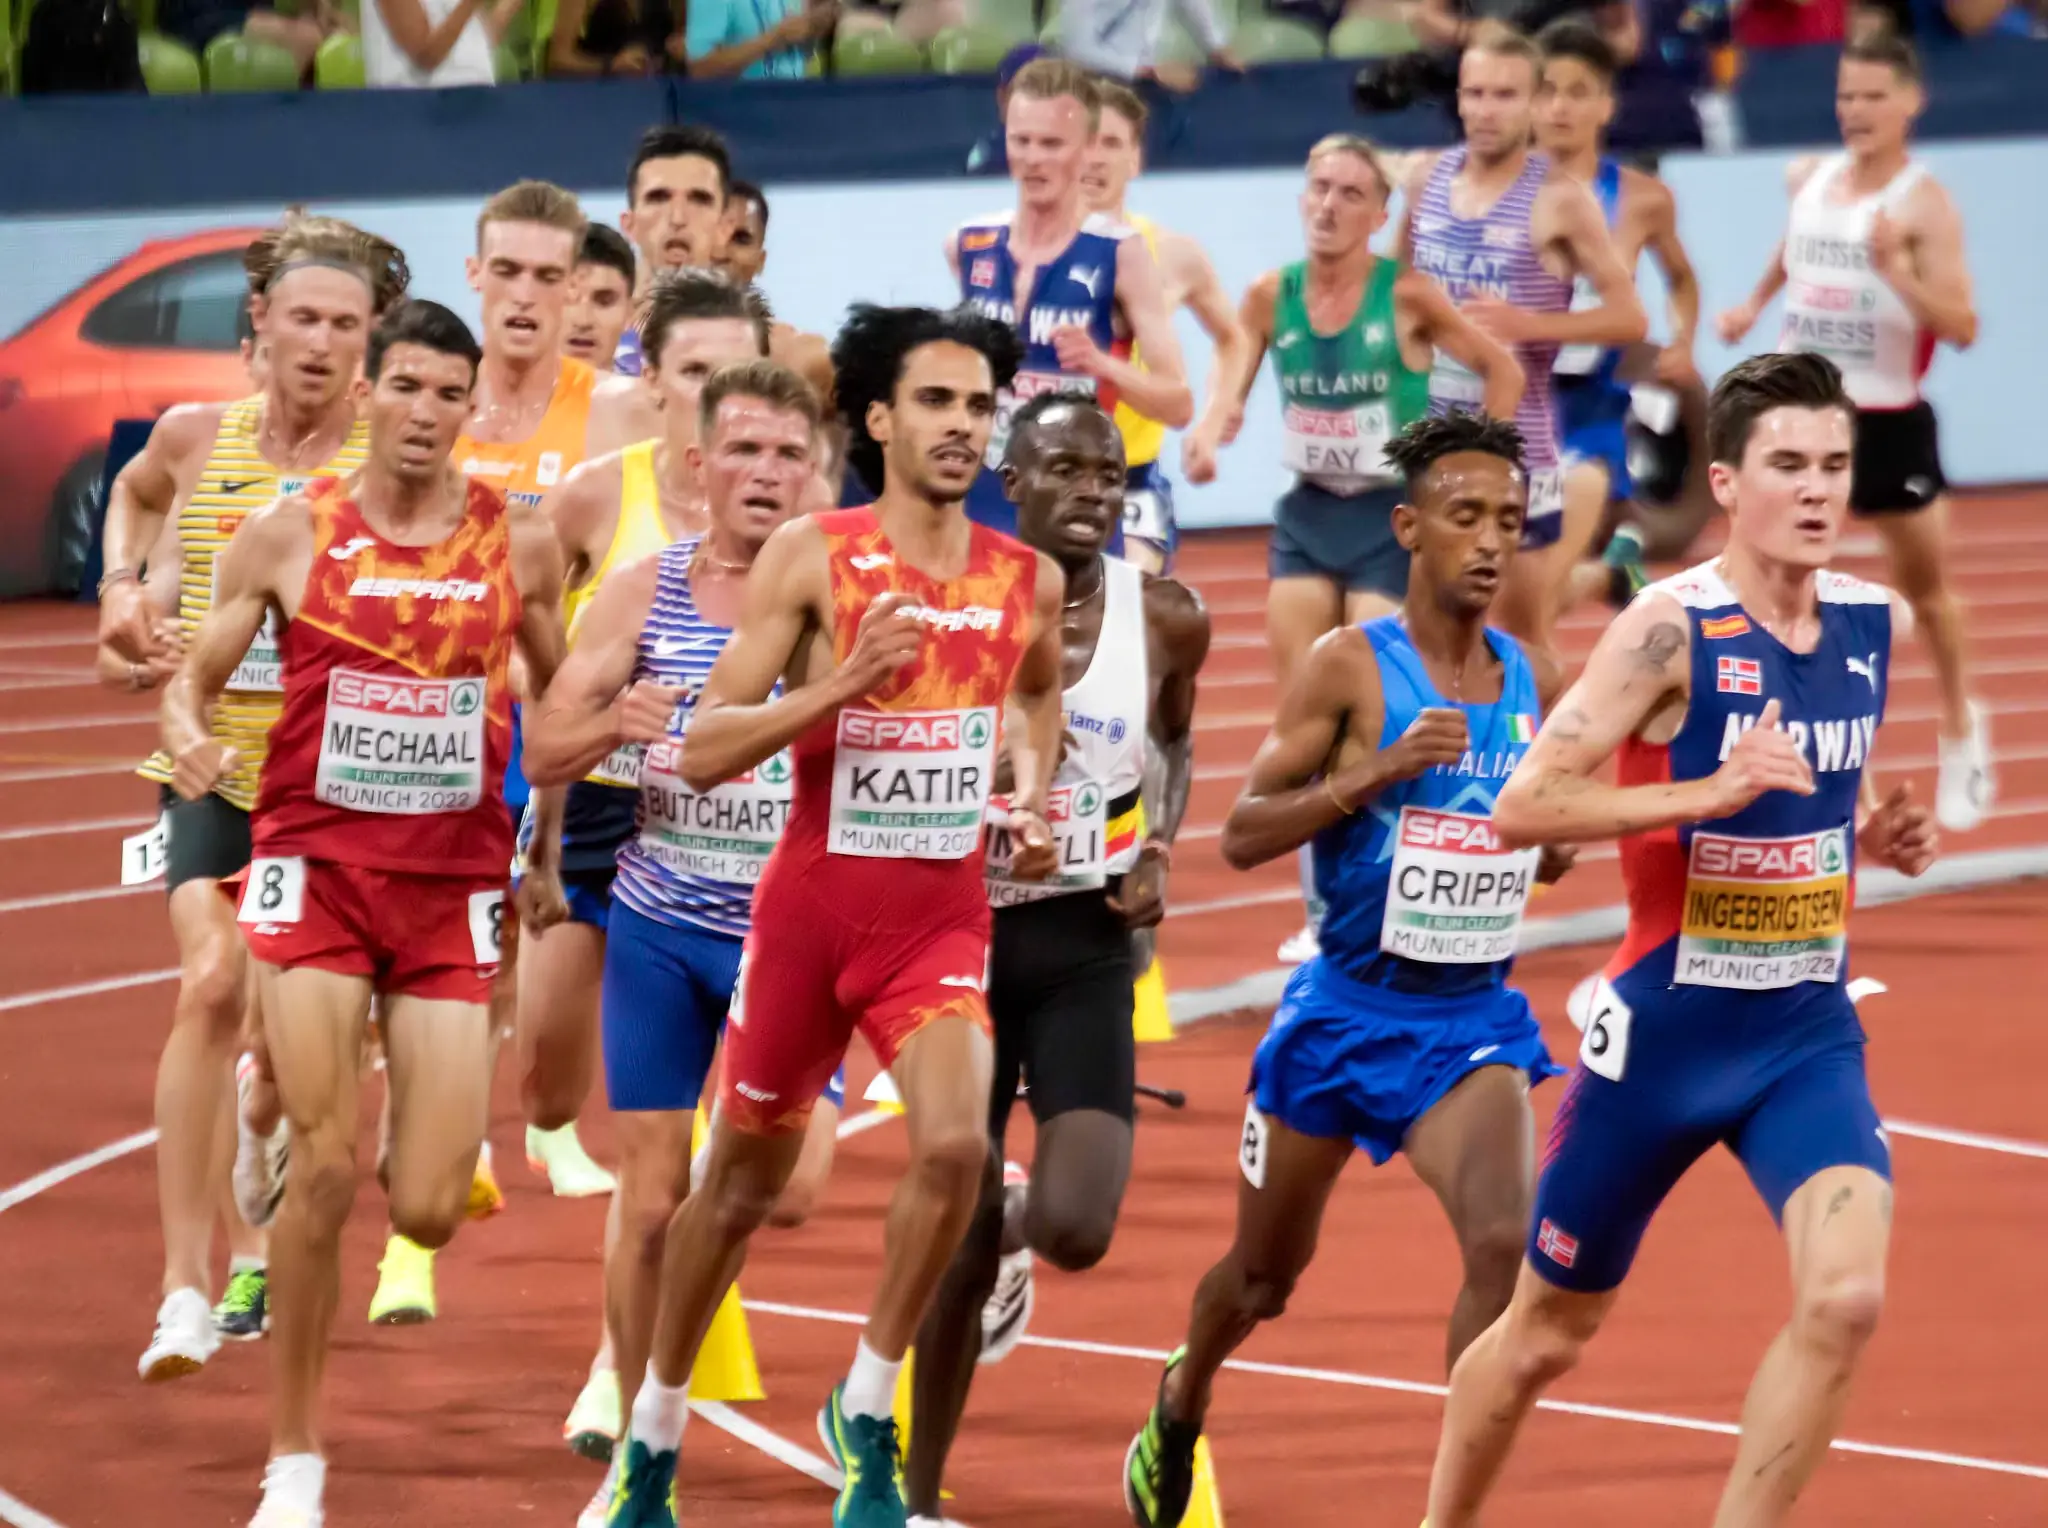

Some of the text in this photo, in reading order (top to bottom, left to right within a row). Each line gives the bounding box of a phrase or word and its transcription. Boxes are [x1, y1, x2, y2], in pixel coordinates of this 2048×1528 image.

[1305, 445, 1360, 472] FAY
[348, 577, 488, 601] ESPAÑA
[334, 679, 447, 713] SPAR
[328, 721, 476, 765] MECHAAL
[845, 718, 958, 748] SPAR
[326, 784, 470, 808] MUNICH 2022
[850, 766, 980, 803] KATIR
[647, 787, 793, 832] BUTCHART
[879, 814, 911, 826] RUN
[840, 829, 930, 852] MUNICH
[1404, 816, 1500, 850] SPA
[649, 847, 725, 873] MUNICH
[1699, 842, 1813, 874] SPAR
[259, 864, 284, 910] 8
[1397, 865, 1527, 907] CRIPPA
[1688, 890, 1841, 931] INGEBRIGTSEN
[1391, 930, 1477, 956] MUNICH
[1687, 958, 1780, 982] MUNICH
[1588, 1007, 1612, 1056] 6
[1242, 1122, 1259, 1168] 8
